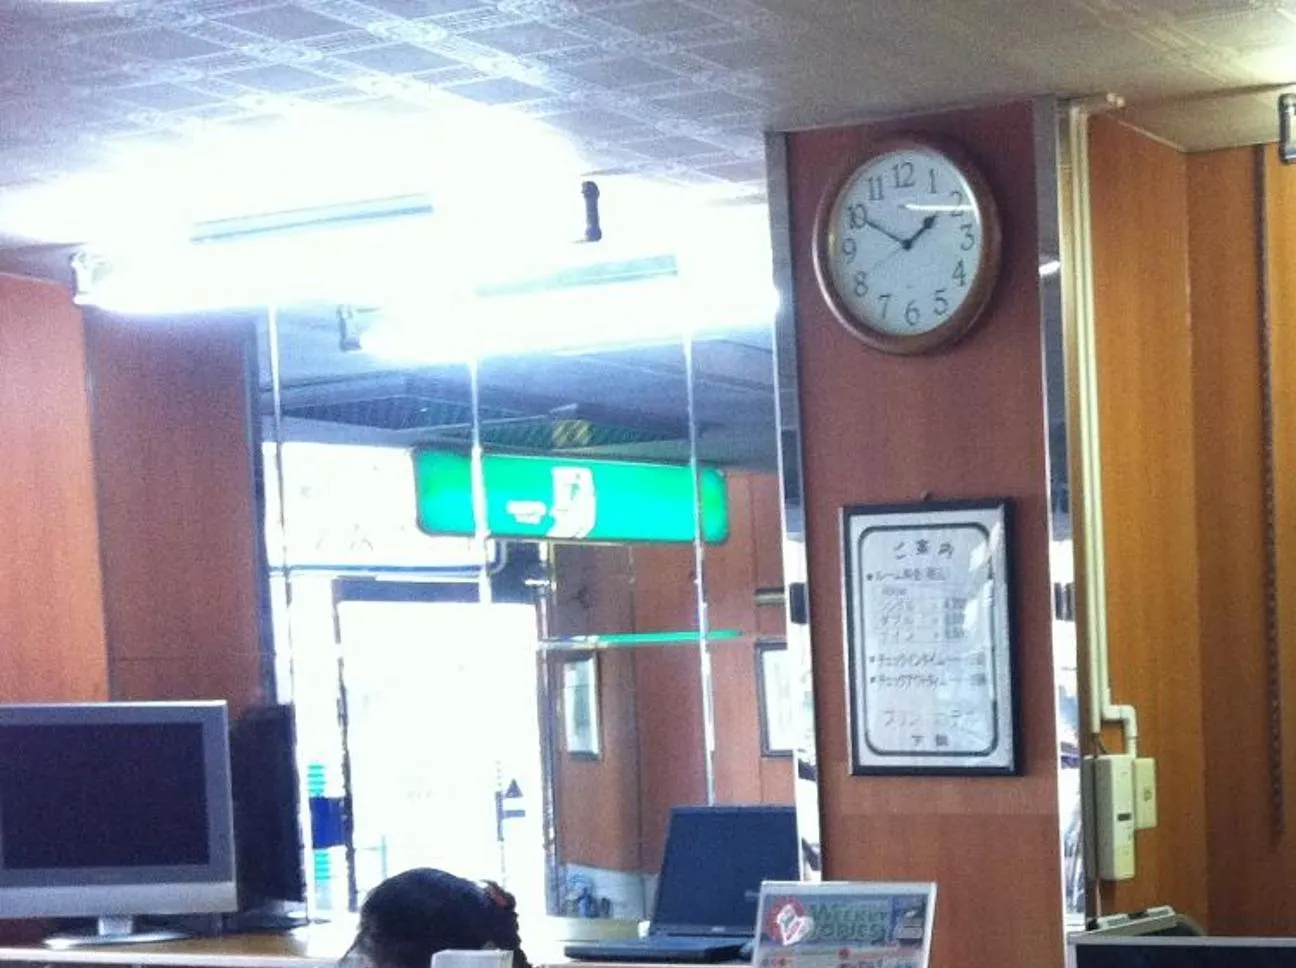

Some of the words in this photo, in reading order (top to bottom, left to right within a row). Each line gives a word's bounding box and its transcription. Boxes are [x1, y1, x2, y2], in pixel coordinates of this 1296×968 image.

[868, 175, 885, 201] 11
[893, 161, 915, 189] 12
[928, 168, 937, 194] 1
[848, 203, 868, 229] 10
[949, 190, 964, 217] 2
[960, 223, 975, 251] 3
[842, 238, 857, 264] 9
[854, 271, 869, 297] 8
[952, 259, 967, 287] 4
[879, 294, 893, 319] 7
[904, 299, 921, 326] 6
[933, 289, 949, 316] 5
